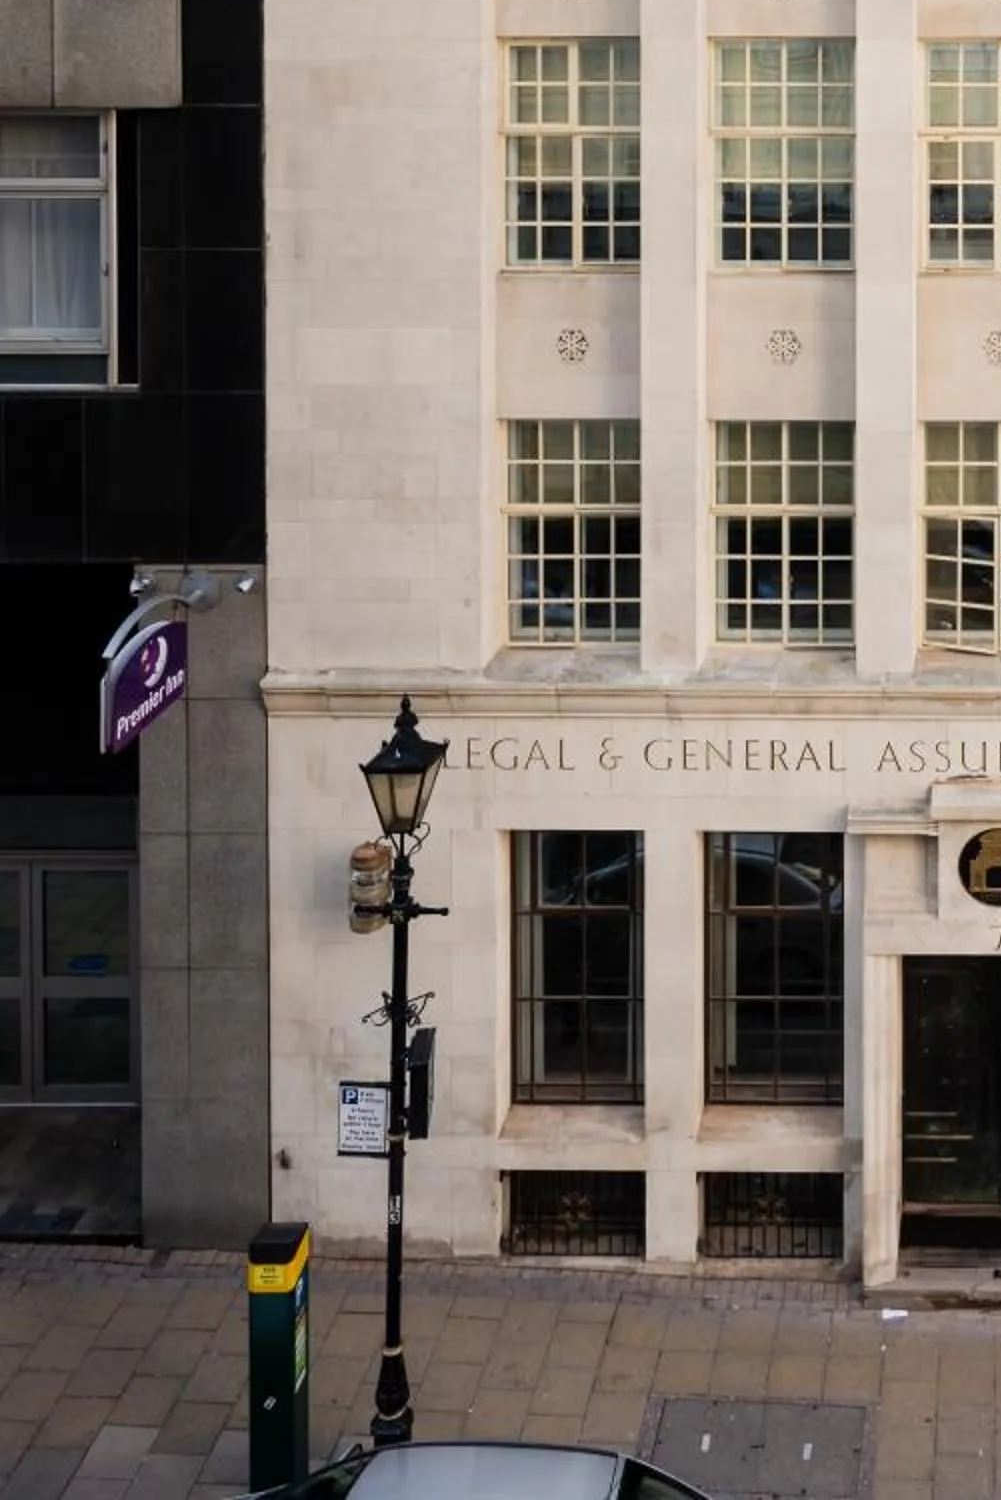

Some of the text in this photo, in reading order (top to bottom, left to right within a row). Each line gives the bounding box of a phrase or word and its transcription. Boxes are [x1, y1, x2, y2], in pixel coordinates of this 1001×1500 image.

[116, 668, 185, 740] Premier Inn
[442, 736, 575, 771] LEGAL
[598, 736, 623, 771] &
[643, 738, 848, 772] GENERAL
[345, 1089, 356, 1103] P
